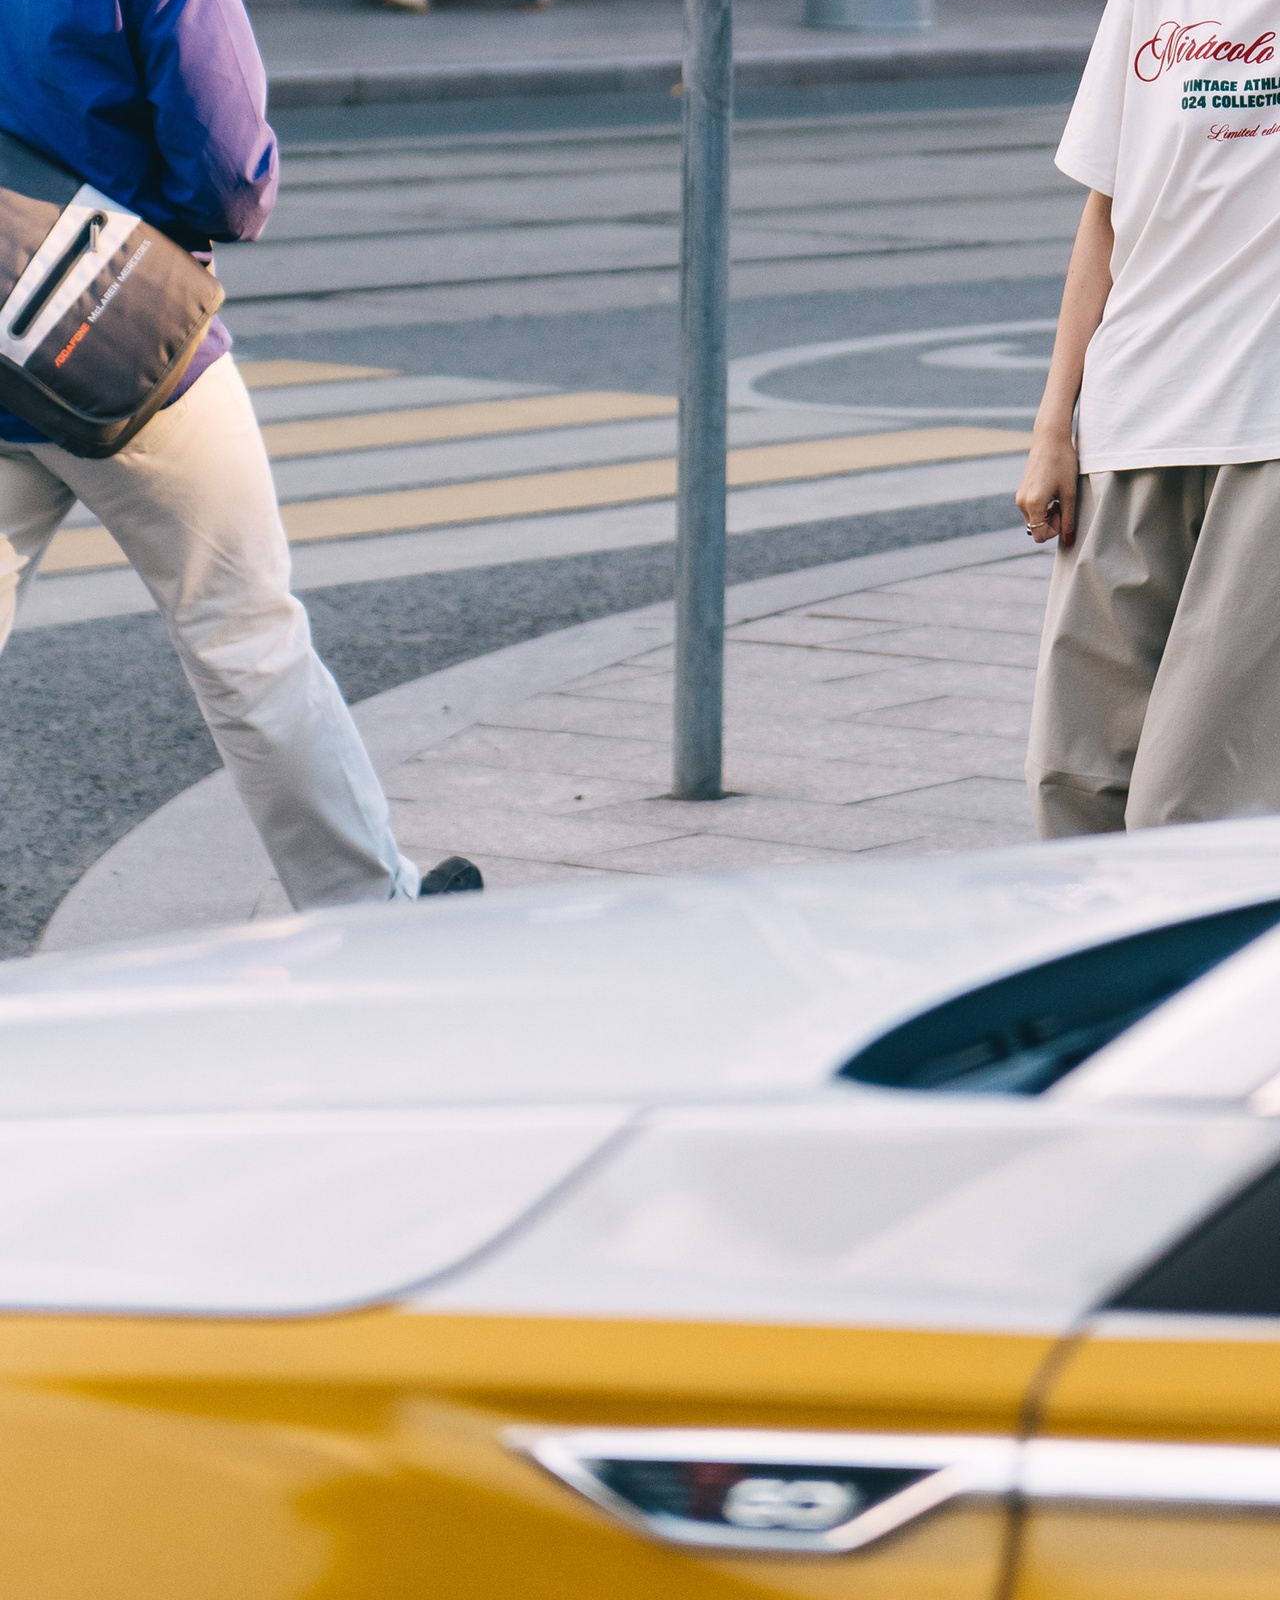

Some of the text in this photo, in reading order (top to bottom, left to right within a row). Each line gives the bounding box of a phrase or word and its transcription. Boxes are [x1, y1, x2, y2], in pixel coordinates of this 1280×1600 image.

[1183, 79, 1238, 93] VINTAGE
[1181, 94, 1207, 110] 024
[1207, 123, 1260, 142] Limited
[86, 281, 121, 323] McLAREN
[116, 238, 152, 282] MERCEDES
